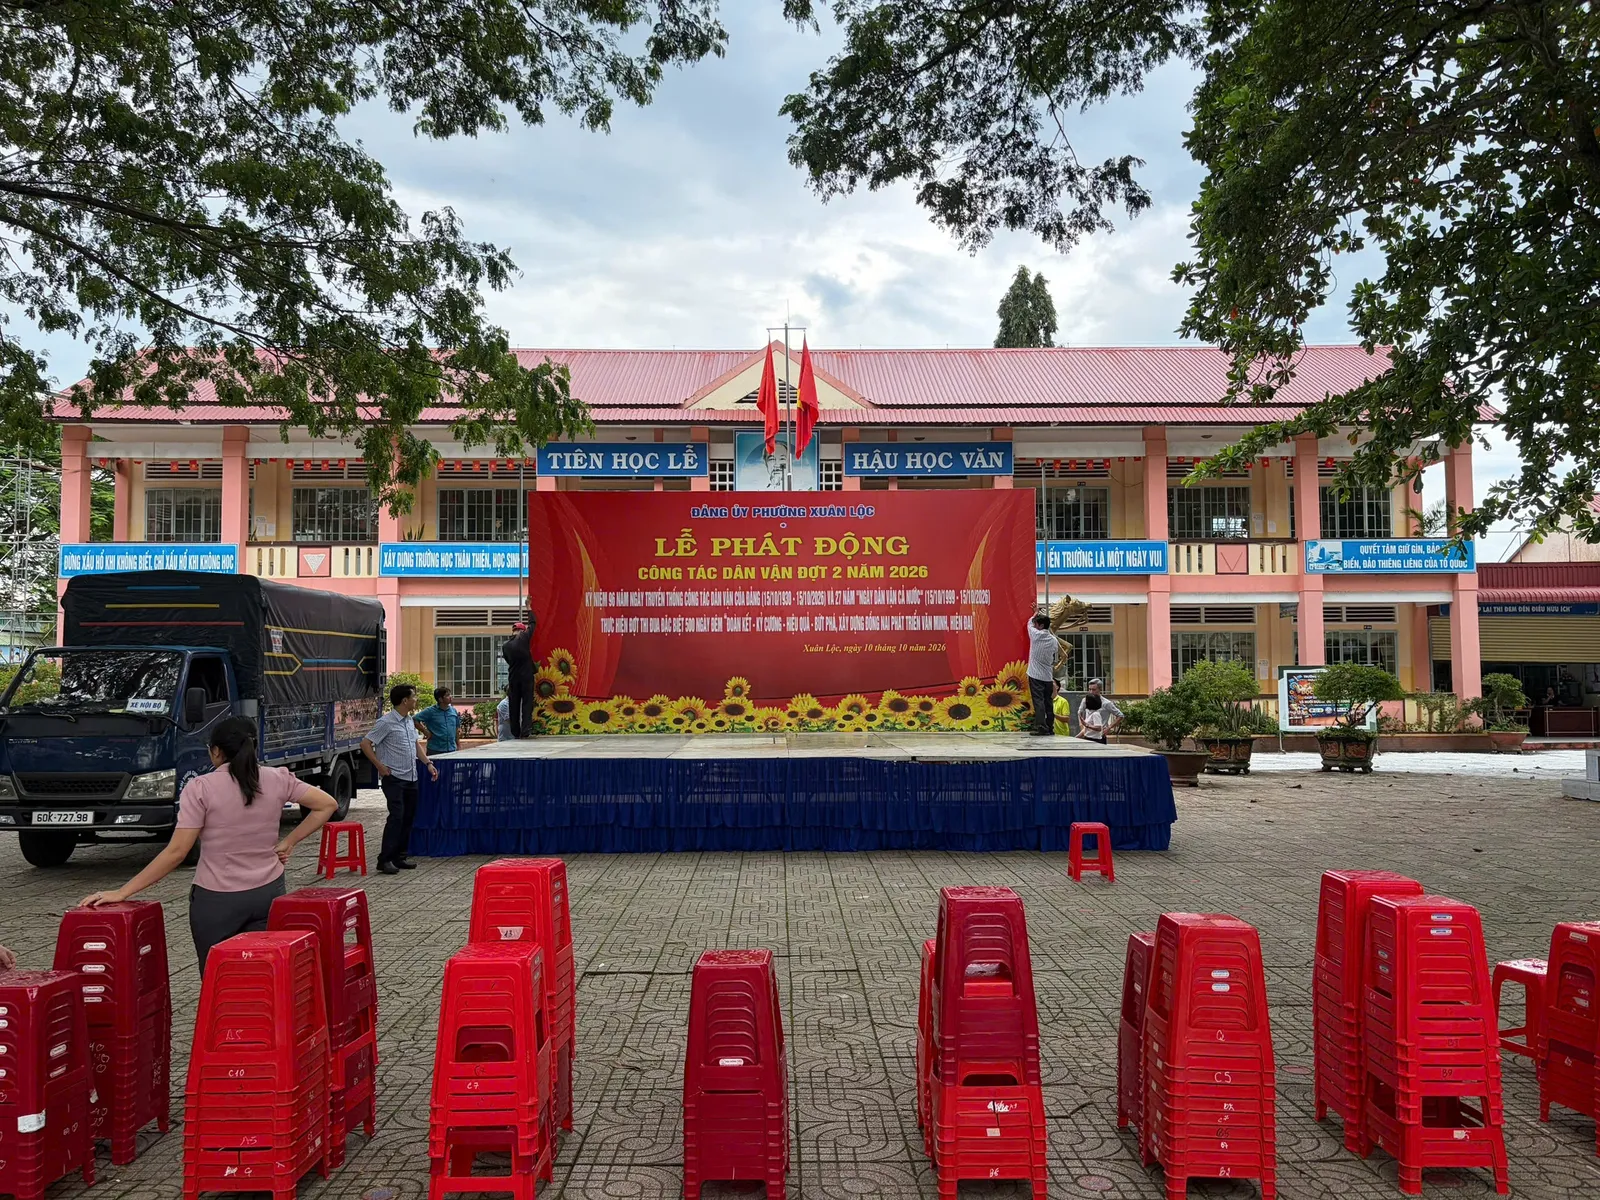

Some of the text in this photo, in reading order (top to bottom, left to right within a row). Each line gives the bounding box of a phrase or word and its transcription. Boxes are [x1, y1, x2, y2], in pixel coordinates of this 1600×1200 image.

[547, 444, 698, 473] TIÊN HỌC LỄ
[852, 448, 1004, 473] HẬU HỌC VĂN
[690, 504, 876, 520] ĐẢNG ỦY PHƯỜNG XUÂN LỘC
[655, 528, 910, 560] LỄ PHÁT ĐỘNG
[64, 552, 80, 570] ĐỪNG
[82, 550, 94, 570] XẤU
[96, 549, 104, 570] HỔ
[105, 555, 115, 570] KHI
[117, 552, 137, 570] KHÔNG
[154, 550, 164, 570] CHỈ
[165, 550, 178, 570] XẤU
[179, 549, 188, 569] HỔ
[188, 554, 199, 570] KHI
[200, 552, 220, 570] KHÔNG
[222, 554, 234, 573] HỌC
[384, 549, 395, 568] XÂY
[396, 550, 414, 571] DỰNG
[415, 549, 439, 568] TRƯỜNG
[441, 552, 453, 571] HỌC
[454, 550, 470, 568] THÂN
[472, 549, 491, 571] THIỆN,
[493, 552, 505, 571] HỌC
[1062, 548, 1093, 568] TRƯỜNG
[1095, 546, 1105, 568] LÀ
[1107, 548, 1124, 571] MỘT
[1126, 546, 1146, 567] NGÀY
[1149, 550, 1162, 567] VUI
[638, 562, 928, 582] CÔNG TÁC DÂN VẬN ĐỢT 2 NĂM 2026
[803, 644, 823, 652] Xuân
[826, 644, 841, 654] Lộc,
[843, 644, 862, 654] ngày
[864, 643, 873, 652] 10
[874, 644, 896, 653] tháng
[909, 643, 926, 652] năm
[928, 643, 946, 652] 2026
[36, 813, 88, 822] 60K-727.98
[228, 1069, 244, 1078] C10
[1215, 1072, 1231, 1083] C5
